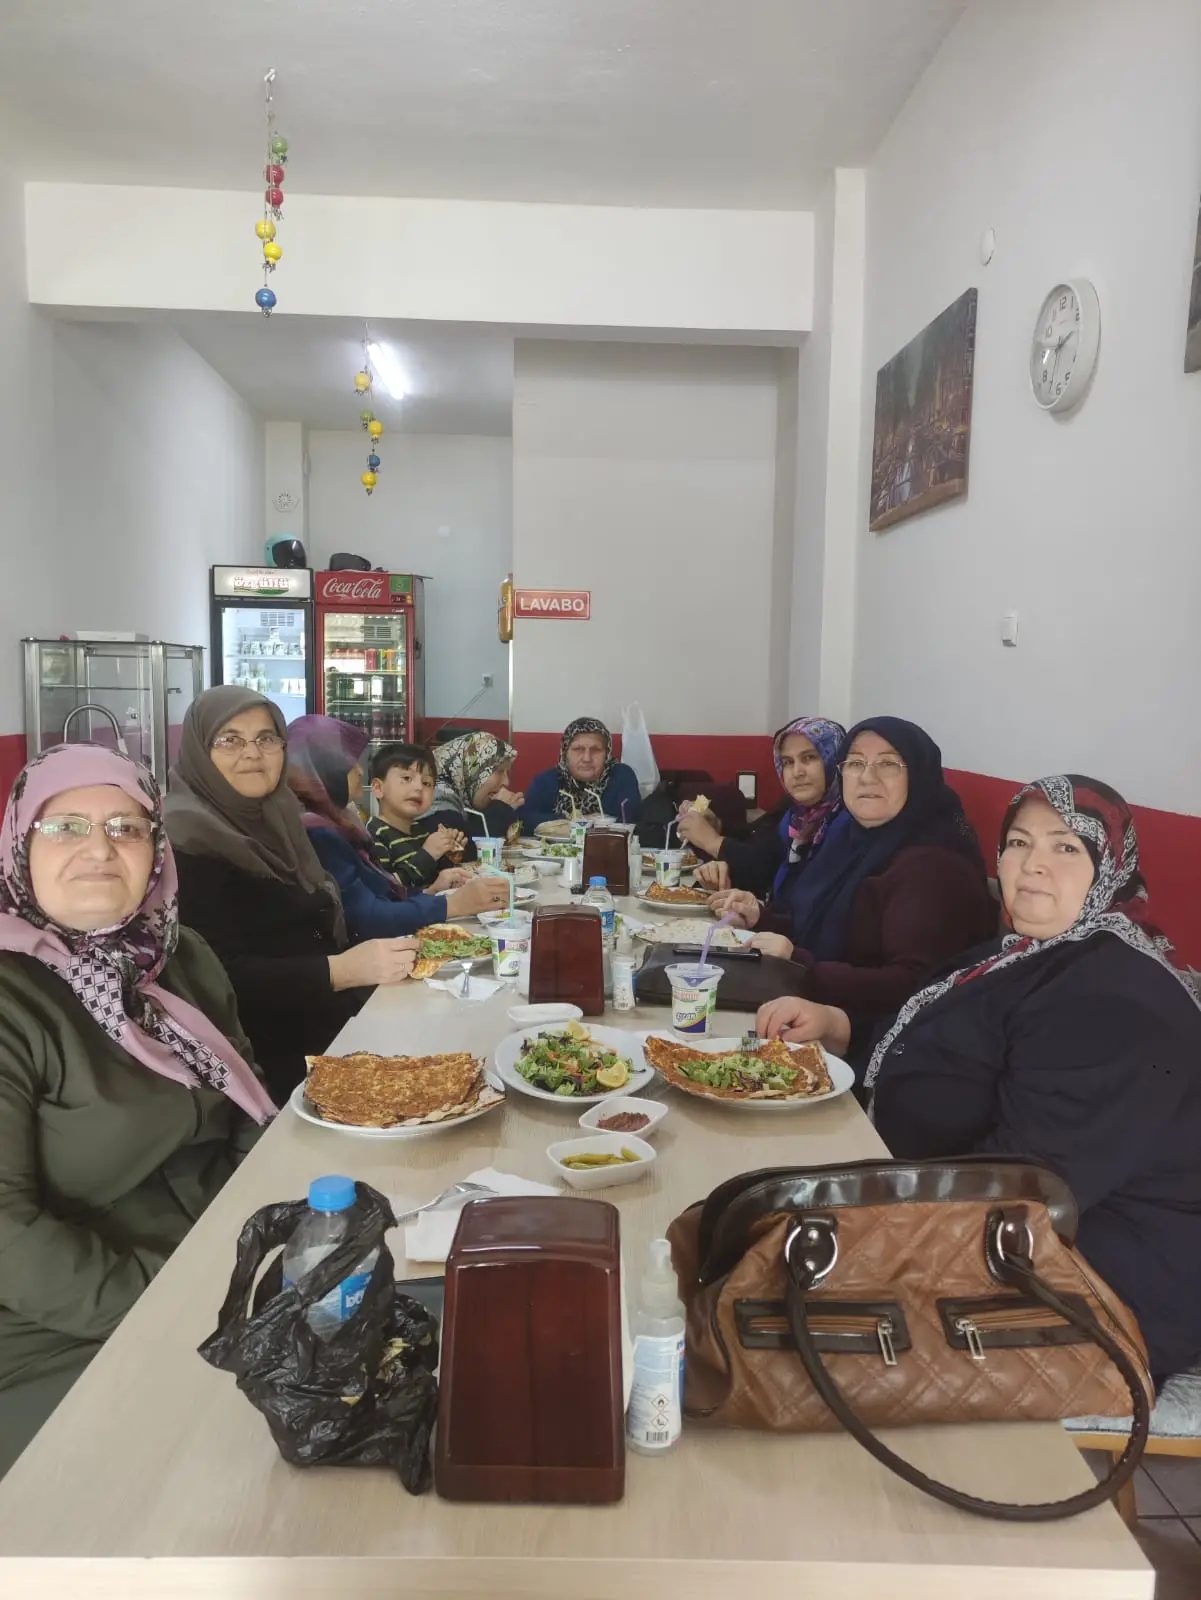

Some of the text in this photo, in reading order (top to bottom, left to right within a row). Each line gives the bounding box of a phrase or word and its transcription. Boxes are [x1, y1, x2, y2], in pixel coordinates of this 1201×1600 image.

[1059, 295, 1067, 311] 12
[1045, 325, 1052, 338] 10
[1042, 369, 1048, 383] 8
[1055, 383, 1061, 395] 6
[322, 577, 384, 599] Coca-Cola
[520, 597, 585, 612] LAVABO
